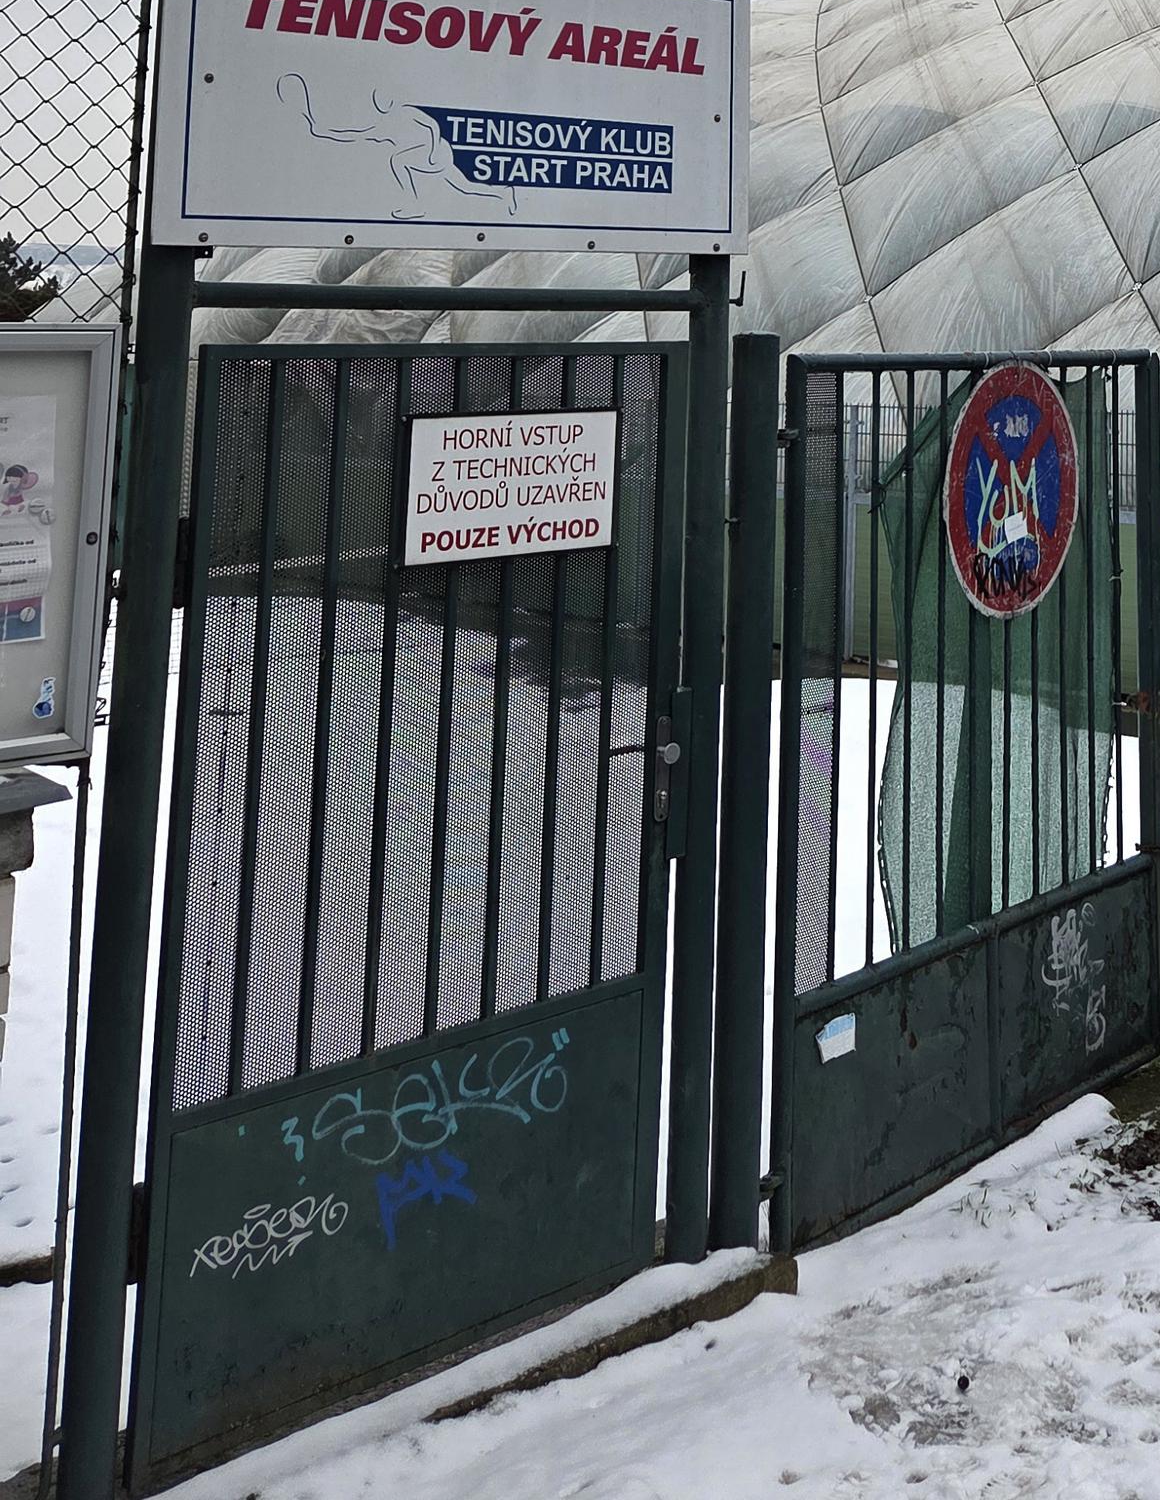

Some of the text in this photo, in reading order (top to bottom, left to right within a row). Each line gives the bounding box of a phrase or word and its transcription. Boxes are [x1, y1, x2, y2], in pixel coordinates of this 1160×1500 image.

[547, 26, 705, 76] AREÁL
[446, 115, 671, 156] TENISOVÝ KLUB
[473, 155, 669, 189] START PRAHA
[443, 420, 584, 450] HORNÍ VSTUP
[431, 447, 596, 482] Z TECHNICKÝCH
[416, 476, 607, 514] DŮVODŮ UZAVŘEN
[420, 516, 600, 553] POUZE VÝCHOD
